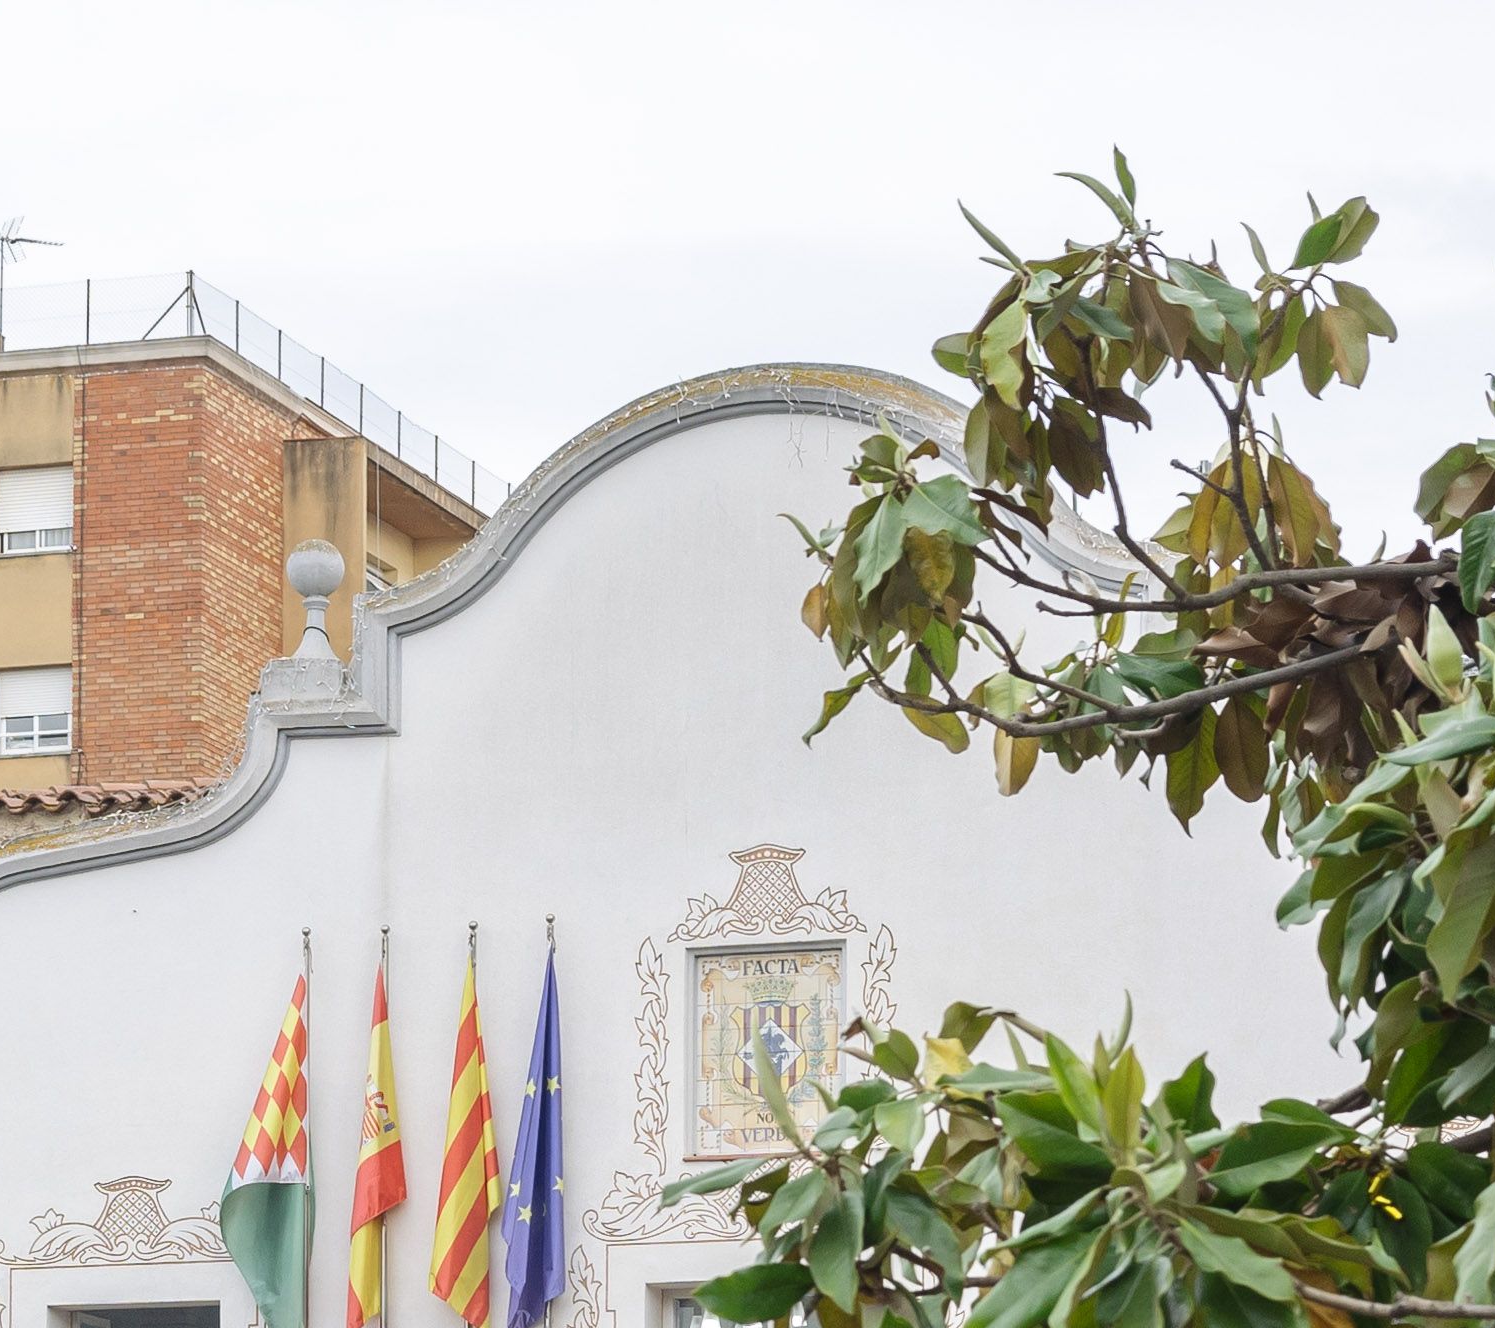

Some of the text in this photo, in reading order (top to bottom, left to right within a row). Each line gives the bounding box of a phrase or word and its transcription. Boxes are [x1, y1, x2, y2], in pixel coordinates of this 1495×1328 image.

[742, 958, 799, 976] FACTA
[757, 1112, 776, 1124] NO
[741, 1127, 787, 1142] VERB
